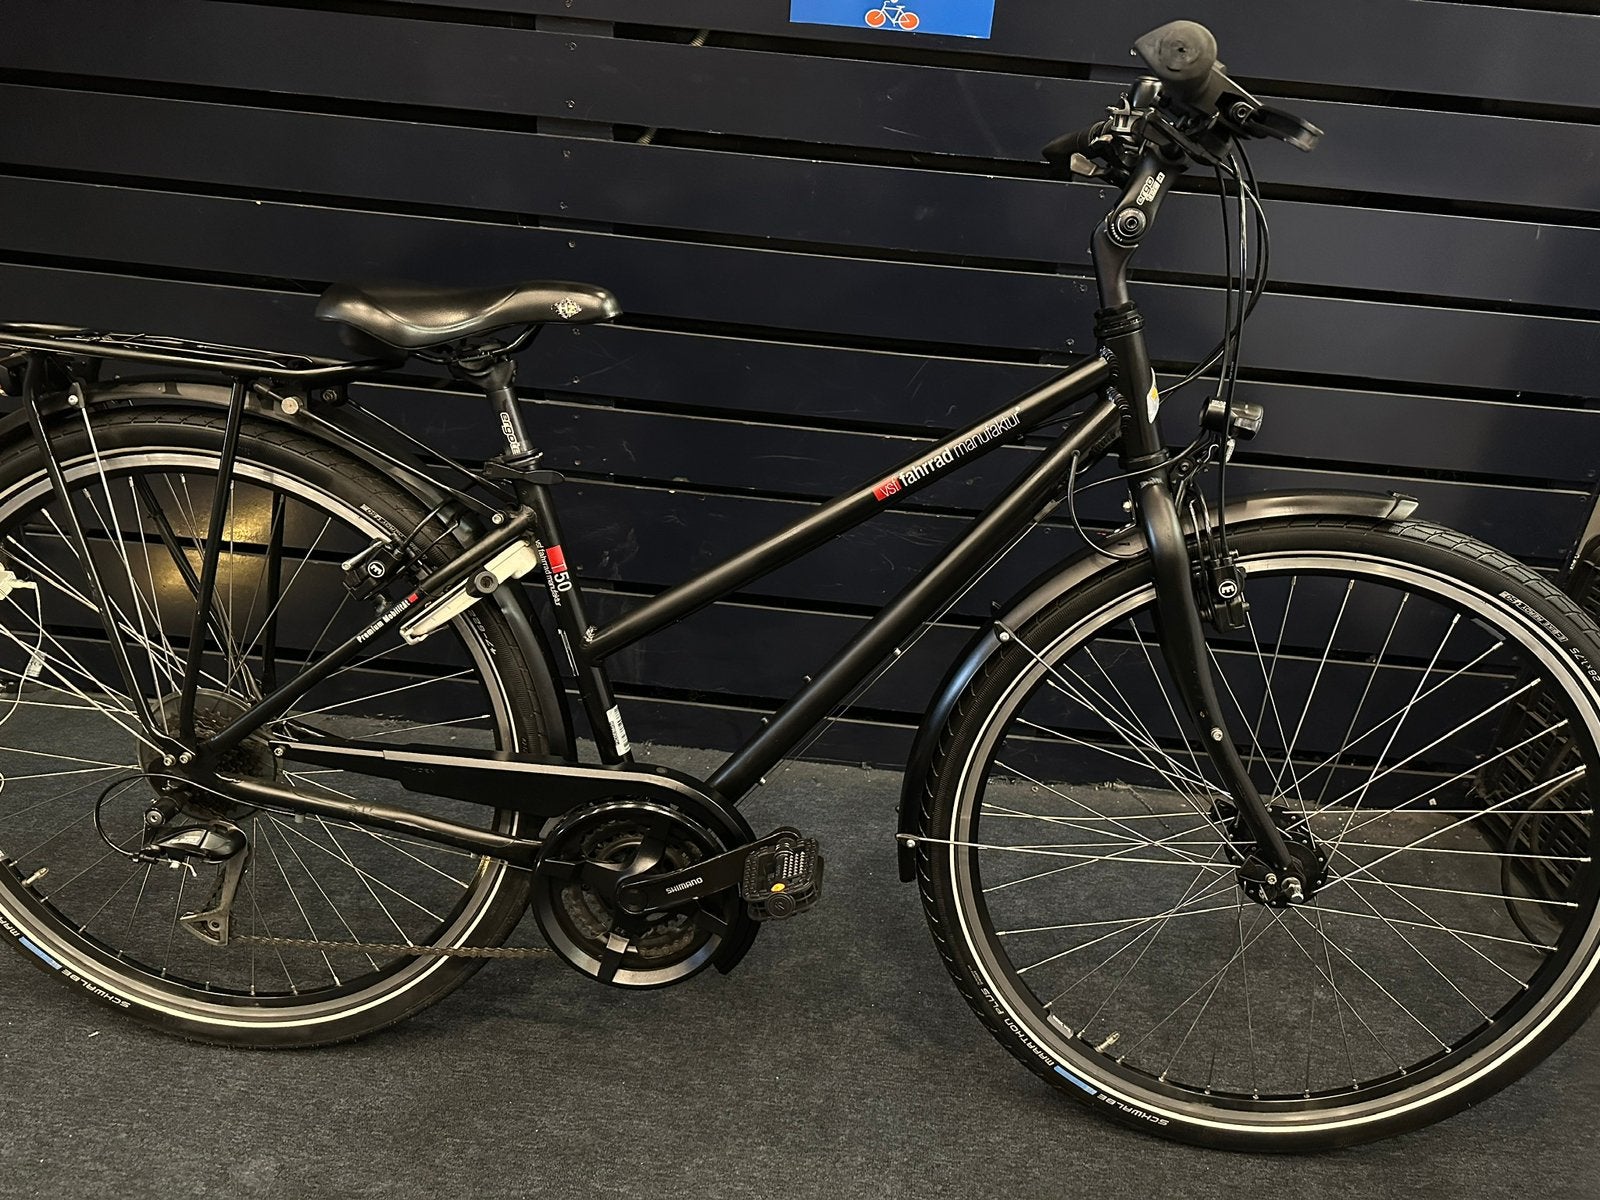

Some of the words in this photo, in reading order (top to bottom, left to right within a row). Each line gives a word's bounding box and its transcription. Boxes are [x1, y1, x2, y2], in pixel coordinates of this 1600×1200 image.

[1136, 176, 1155, 206] ergo
[879, 477, 902, 497] vsf
[900, 447, 954, 487] fahrrad
[953, 410, 1021, 458] manufaktur
[356, 620, 385, 643] Premium
[665, 877, 704, 895] SHIMANO
[61, 968, 131, 1009] SCHWALBE
[981, 987, 1004, 1015] PLUS
[1004, 1018, 1055, 1067] MARATHON
[1097, 1093, 1170, 1126] SCHWALBE
